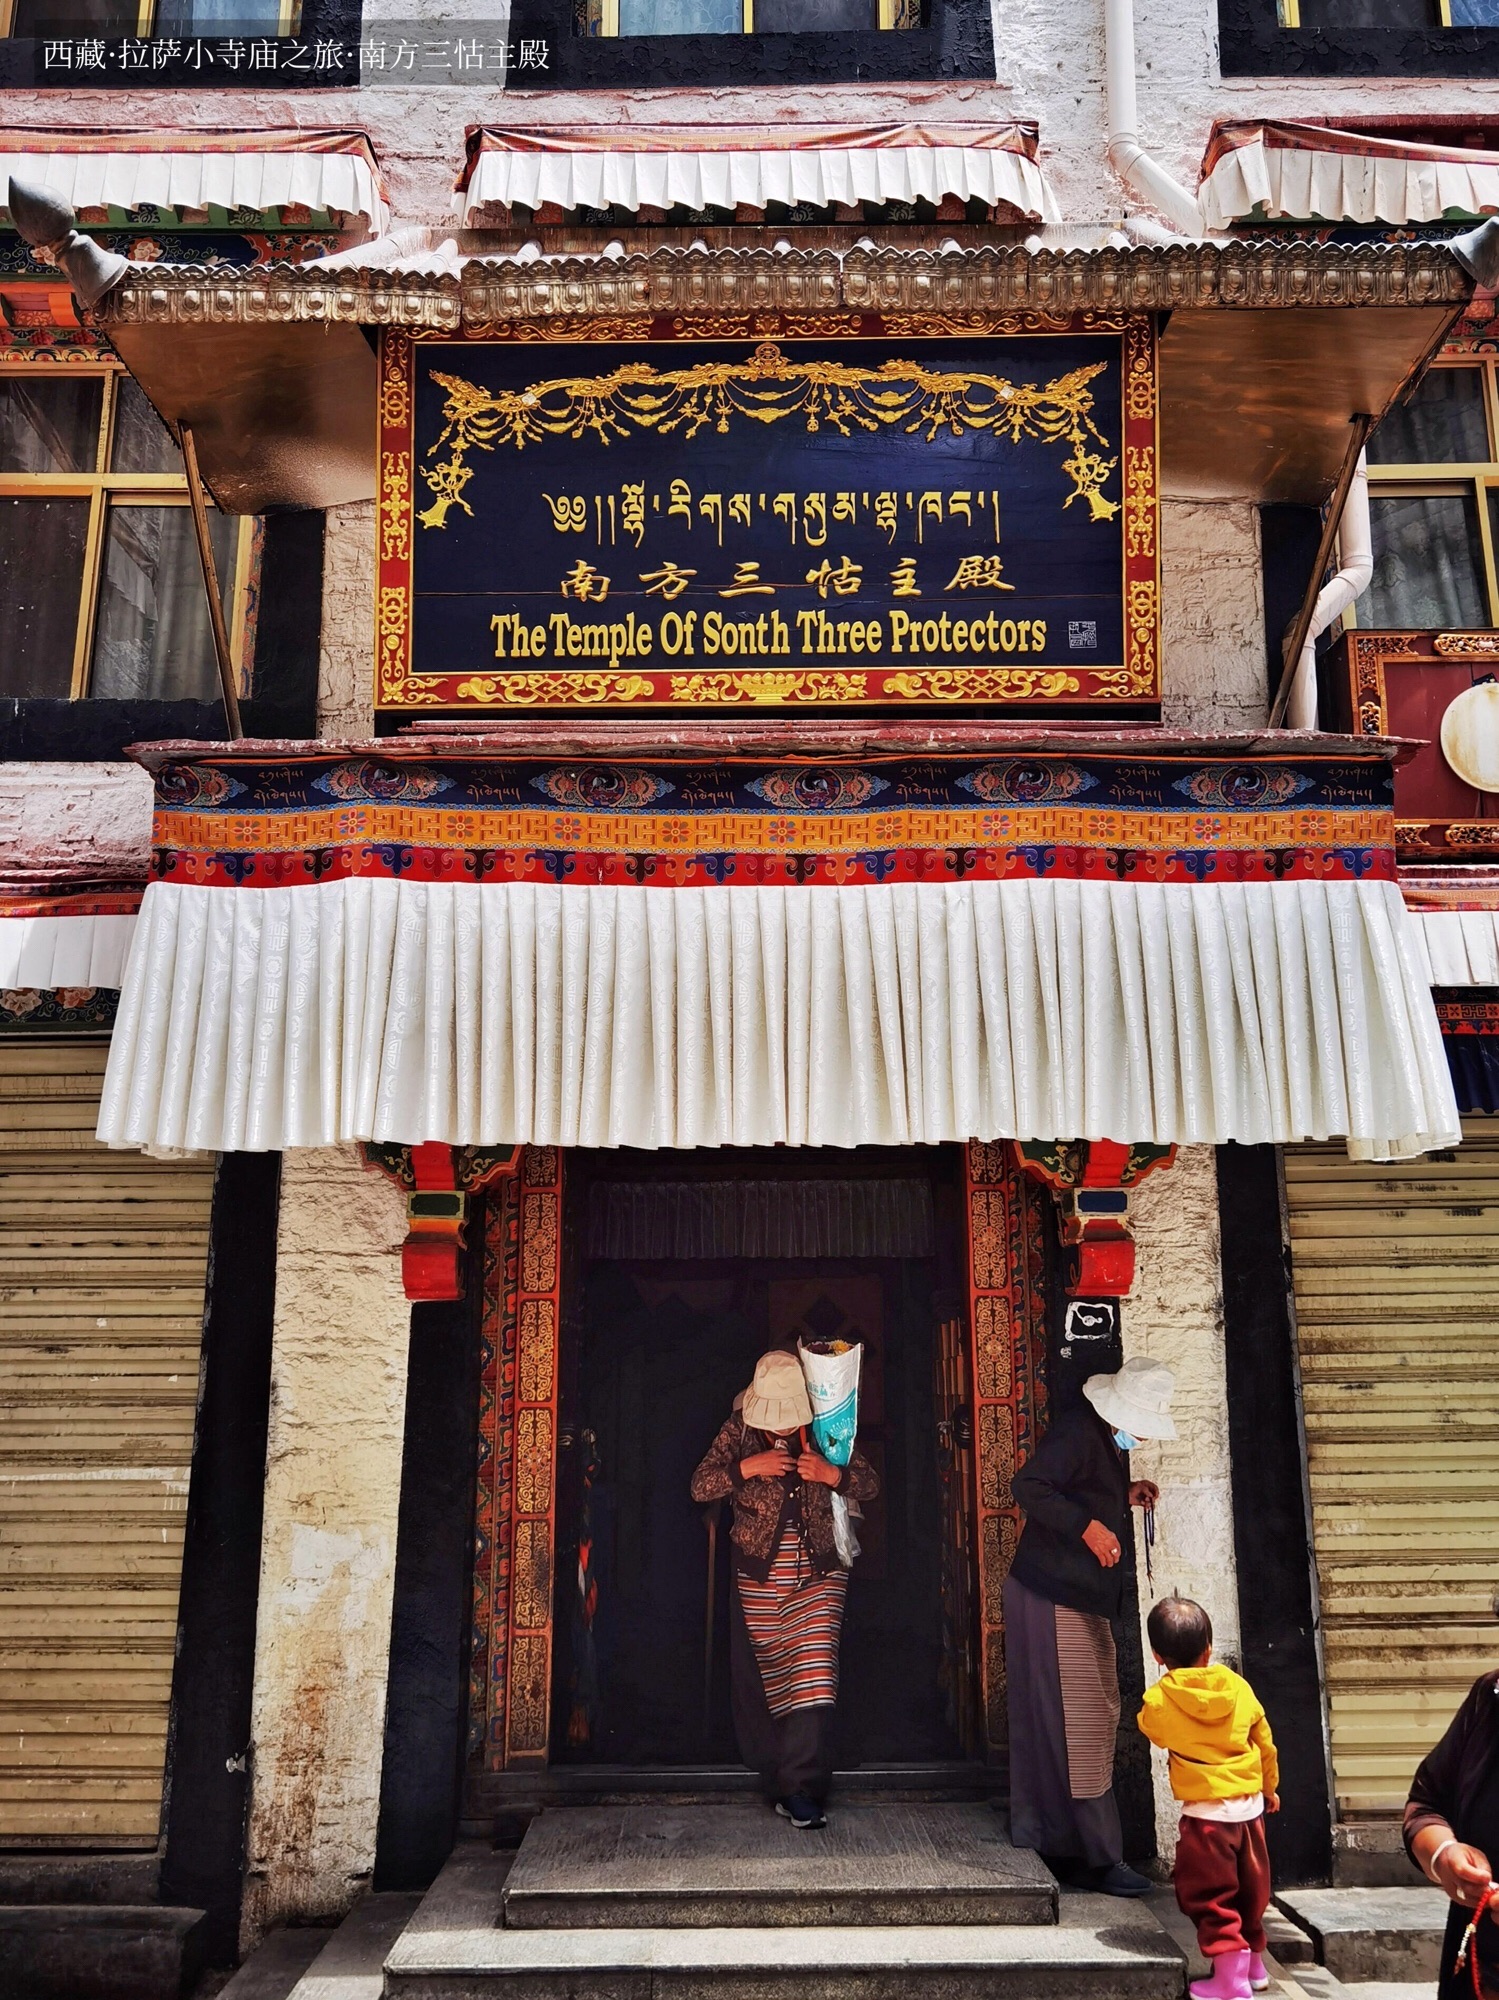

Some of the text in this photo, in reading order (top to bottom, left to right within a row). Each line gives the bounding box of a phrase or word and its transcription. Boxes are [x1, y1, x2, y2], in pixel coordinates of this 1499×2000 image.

[559, 555, 1016, 603] 南方三怙主殿
[489, 613, 547, 659] The
[548, 611, 653, 668] Temple
[660, 609, 698, 656] Of
[702, 609, 791, 655] Sonth
[795, 609, 883, 655] Three
[888, 608, 1048, 654] Protectors
